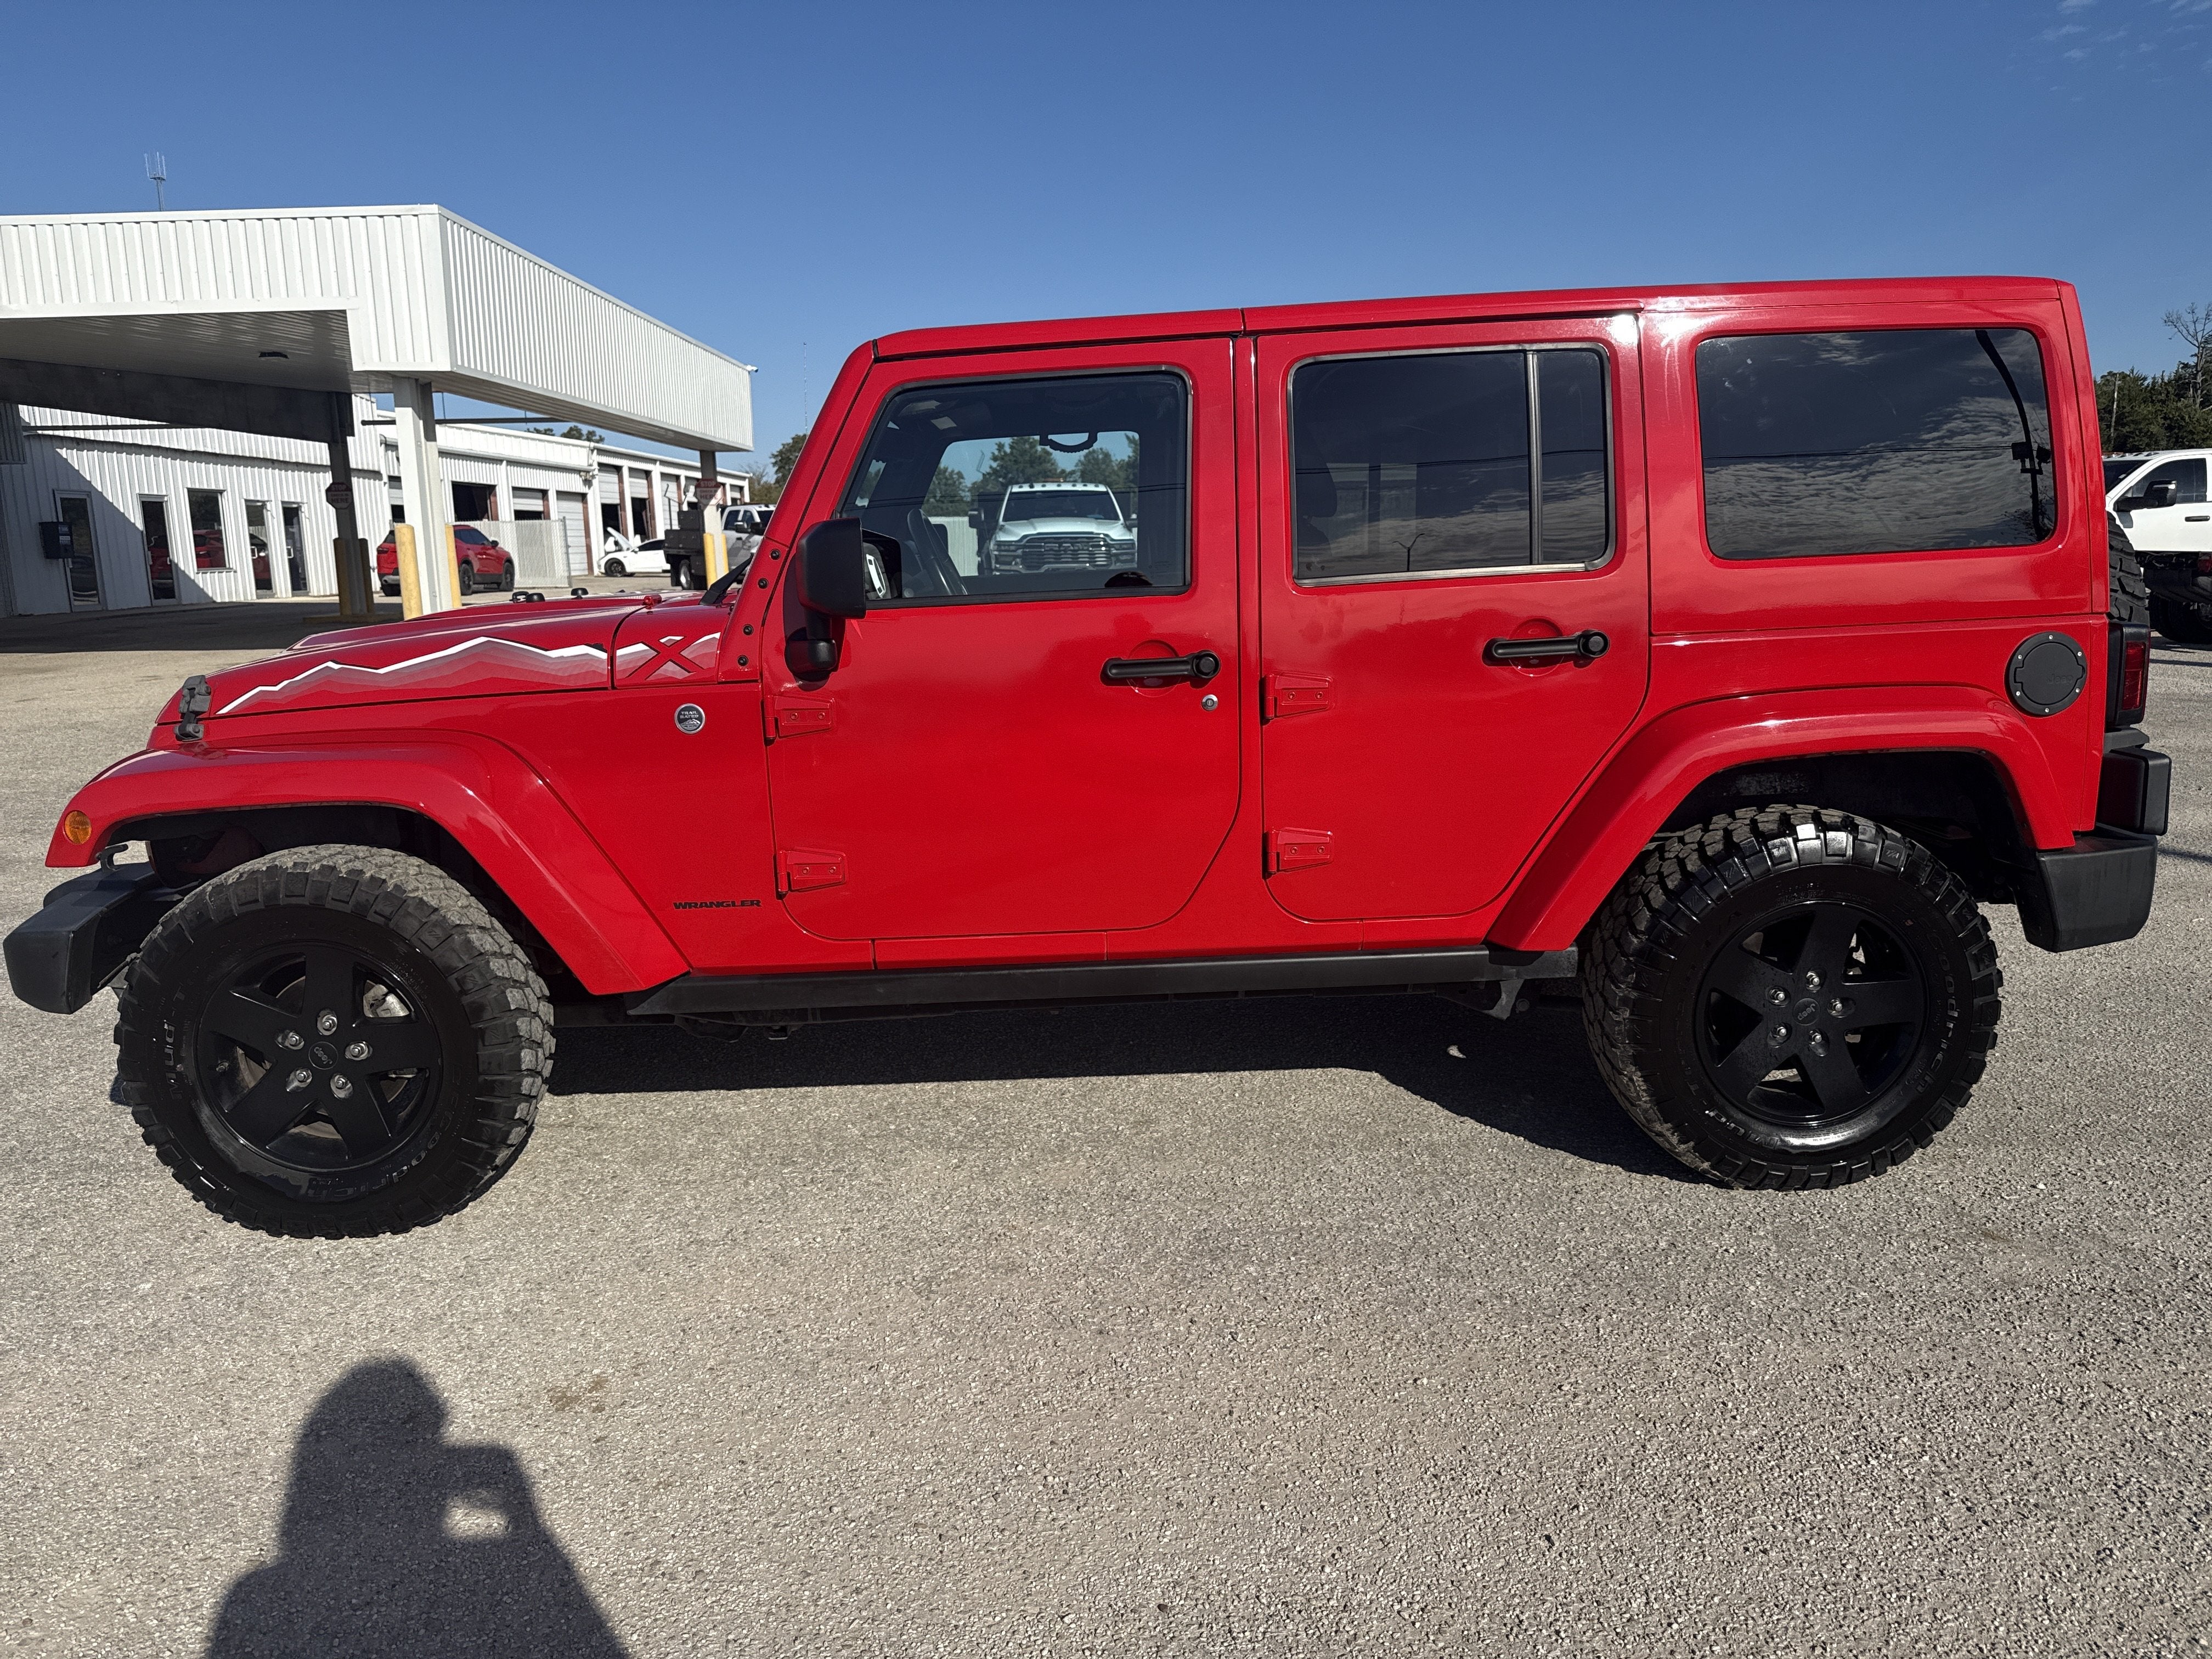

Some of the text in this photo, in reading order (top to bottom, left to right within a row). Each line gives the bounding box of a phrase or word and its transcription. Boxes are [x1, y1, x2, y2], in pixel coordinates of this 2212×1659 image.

[2045, 673, 2074, 685] Jeep
[673, 899, 762, 910] WRANGLER
[1797, 1003, 1816, 1020] Jeep
[314, 1046, 333, 1064] Jeep
